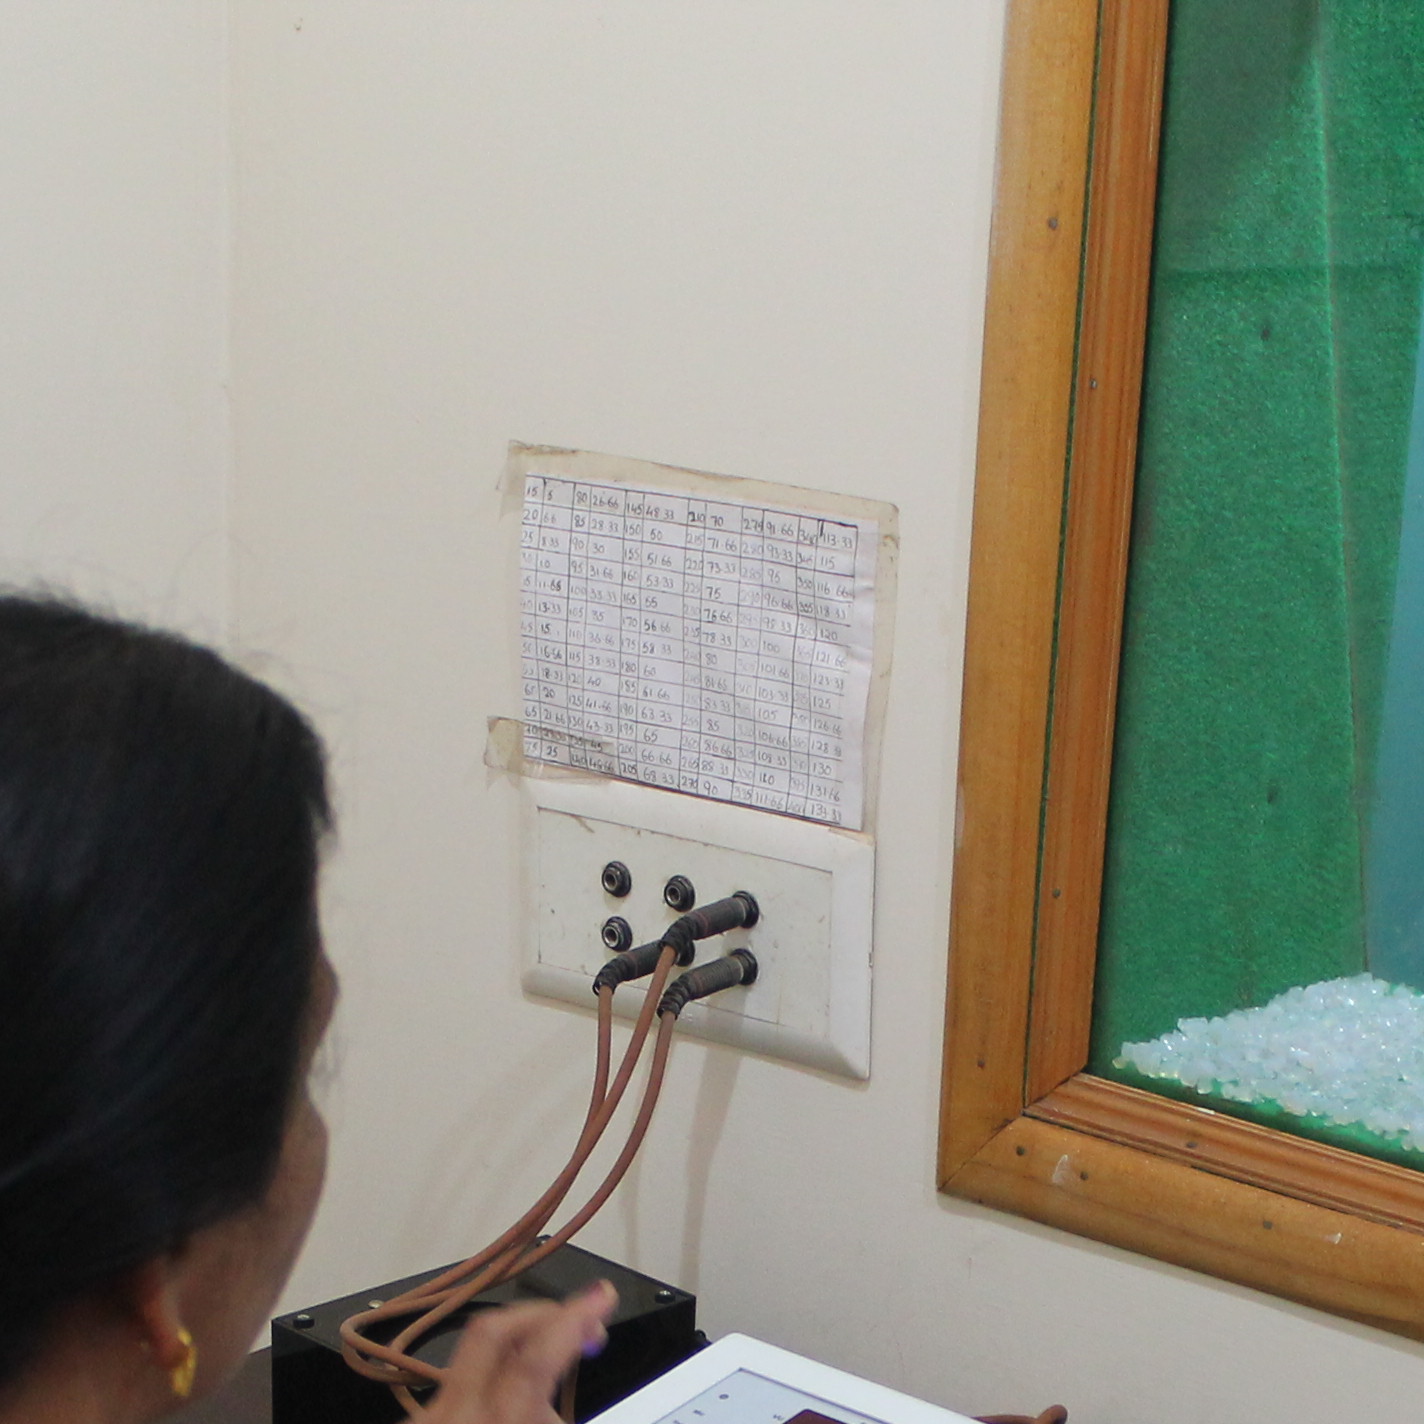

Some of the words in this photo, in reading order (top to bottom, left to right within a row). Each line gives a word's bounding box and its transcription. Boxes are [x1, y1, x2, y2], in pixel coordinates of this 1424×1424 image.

[526, 486, 538, 497] 15
[547, 490, 552, 501] 5
[576, 491, 587, 503] 80
[627, 503, 642, 515] 145
[710, 516, 723, 526] 70
[522, 531, 533, 543] 25
[594, 543, 605, 553] 30
[624, 548, 639, 560] 155
[768, 570, 780, 583] 95
[523, 509, 538, 520] 20
[625, 524, 641, 535] 150
[650, 530, 663, 541] 50
[821, 556, 835, 569] 115
[540, 560, 550, 568] 10
[571, 561, 583, 573] 95
[707, 586, 721, 599] 75
[592, 611, 605, 621] 35
[763, 641, 780, 653] 100
[645, 597, 657, 608] 55
[820, 630, 838, 640] 120
[621, 640, 636, 651] 175
[705, 653, 717, 665] 80
[569, 651, 580, 661] 115
[621, 662, 636, 672] 180
[643, 665, 656, 676] 60
[813, 697, 831, 709] 125
[588, 676, 601, 686] 40
[758, 708, 777, 720] 105
[543, 687, 555, 698] 20
[707, 719, 720, 731] 85
[525, 707, 537, 717] 65
[643, 728, 658, 743] 65
[813, 765, 832, 776] 130
[547, 746, 557, 757] 25
[703, 782, 718, 794] 90
